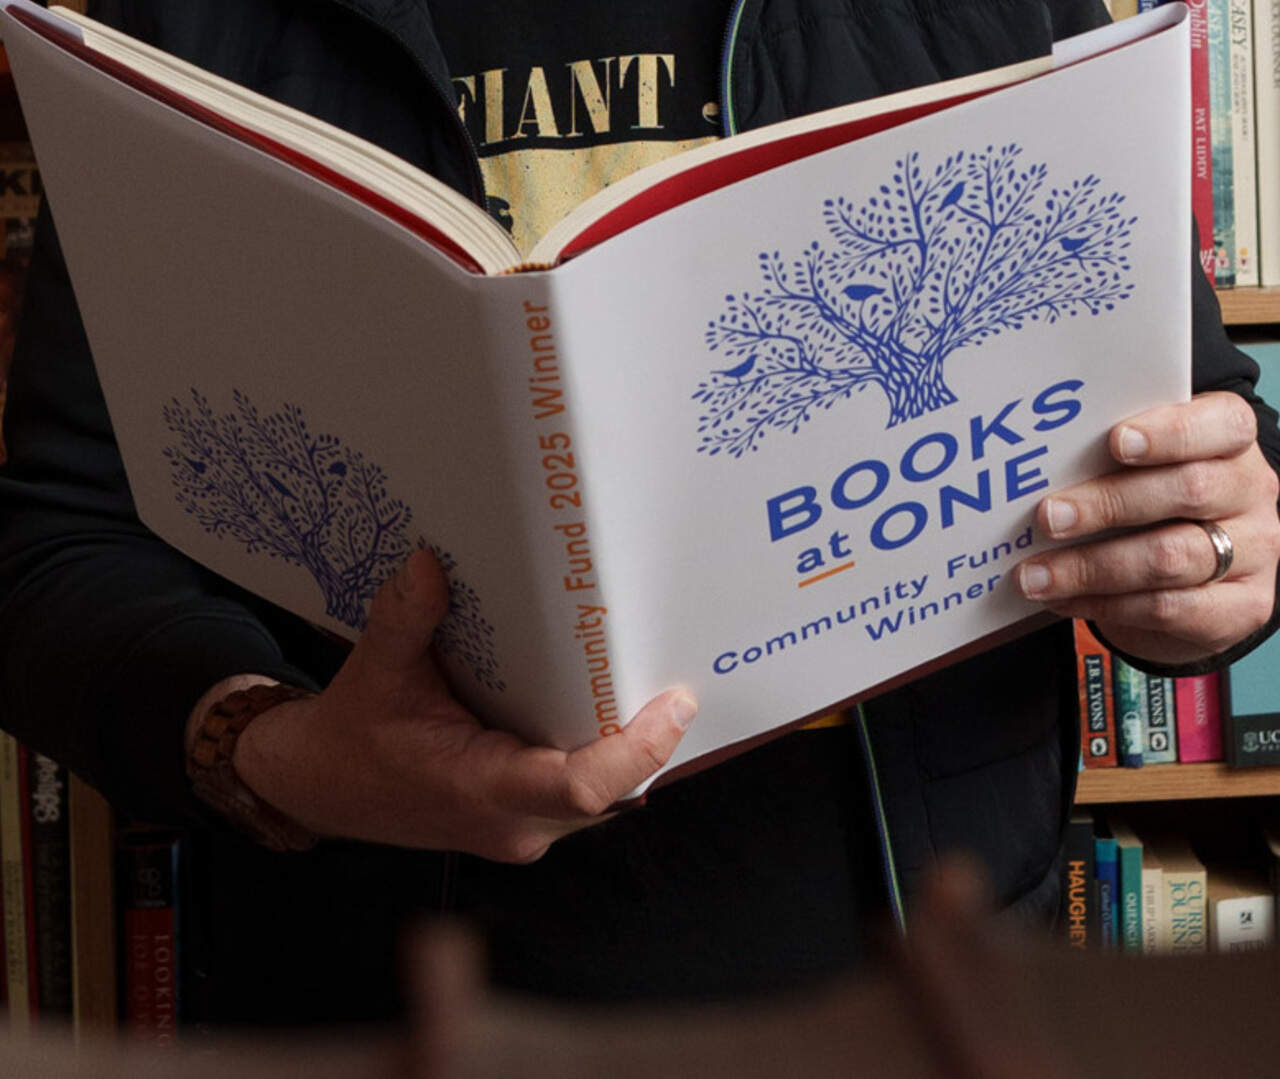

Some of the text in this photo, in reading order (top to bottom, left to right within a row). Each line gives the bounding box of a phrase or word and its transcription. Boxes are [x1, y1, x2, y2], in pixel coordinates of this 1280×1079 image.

[1194, 108, 1209, 180] PAT LIDDY
[766, 379, 1086, 543] BOOKS
[525, 300, 625, 739] ommunity Fund 2025 Winner
[796, 445, 1051, 575] at ONE
[712, 526, 1035, 676] Community Fund
[864, 573, 1003, 643] Winner
[1086, 656, 1104, 731] J.B. LYONS
[1149, 678, 1164, 726] LYONS
[1068, 860, 1086, 949] HAUGHEY
